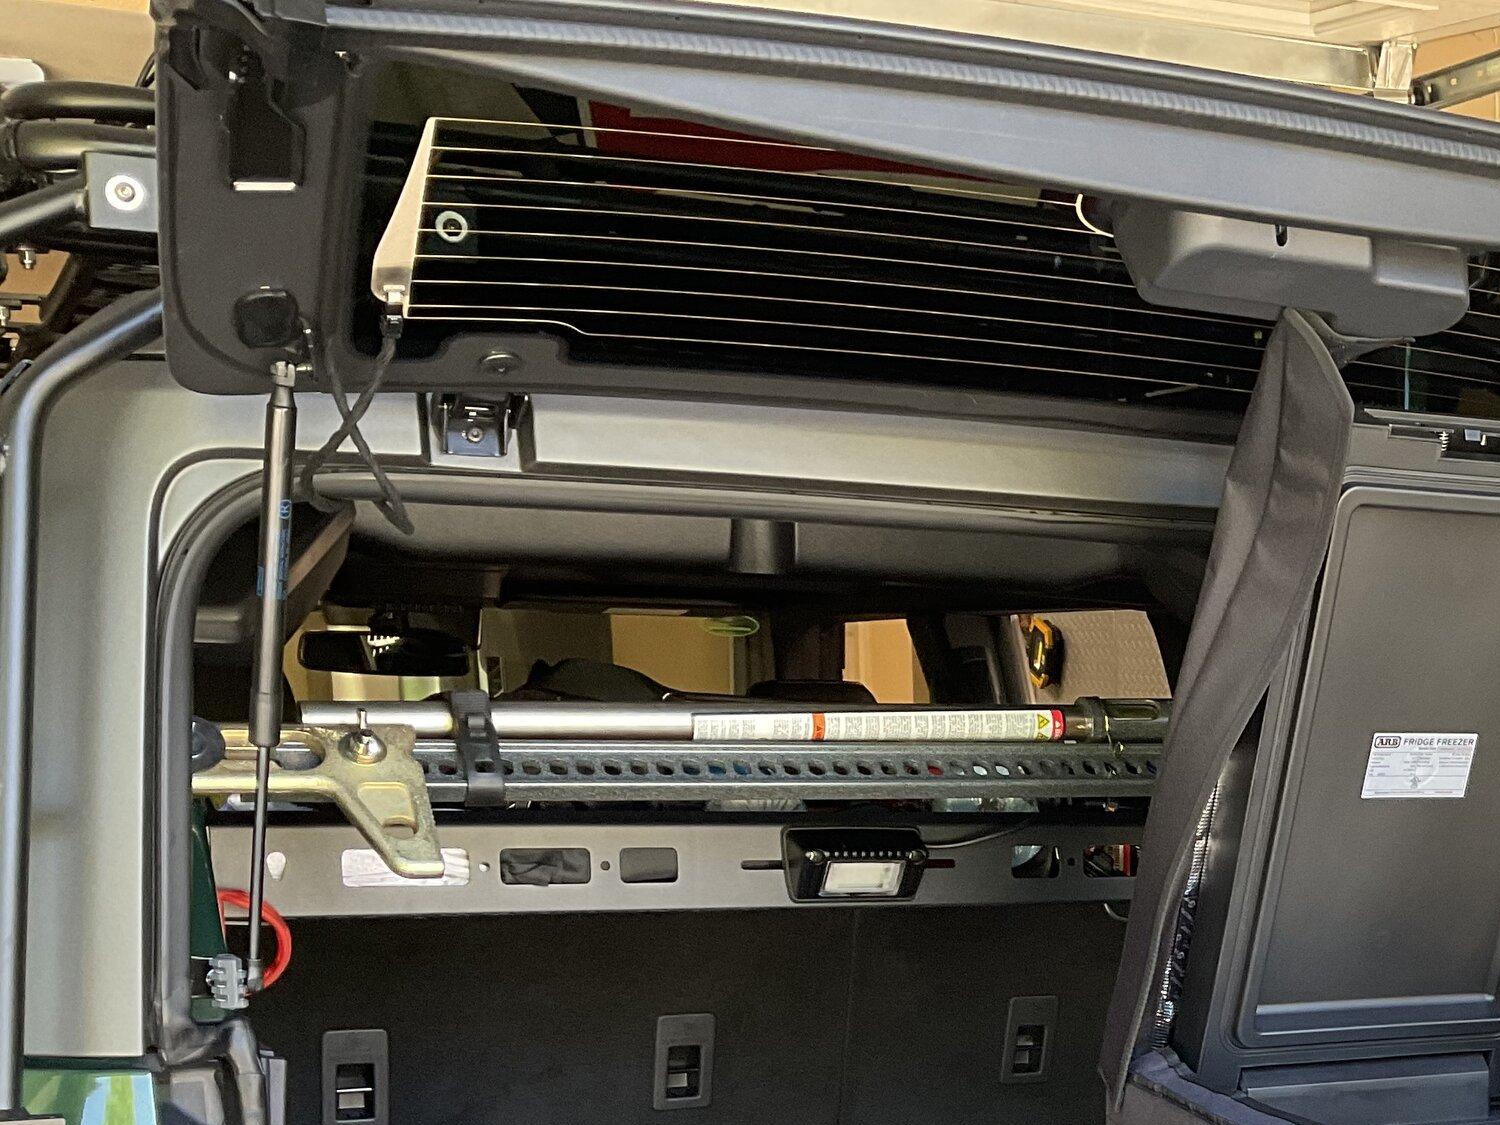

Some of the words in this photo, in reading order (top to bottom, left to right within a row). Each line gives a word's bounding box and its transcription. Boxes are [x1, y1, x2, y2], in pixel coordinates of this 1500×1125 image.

[1378, 738, 1398, 746] ARB
[1403, 737, 1434, 746] FRIDGE
[1436, 738, 1475, 746] FREEZER
